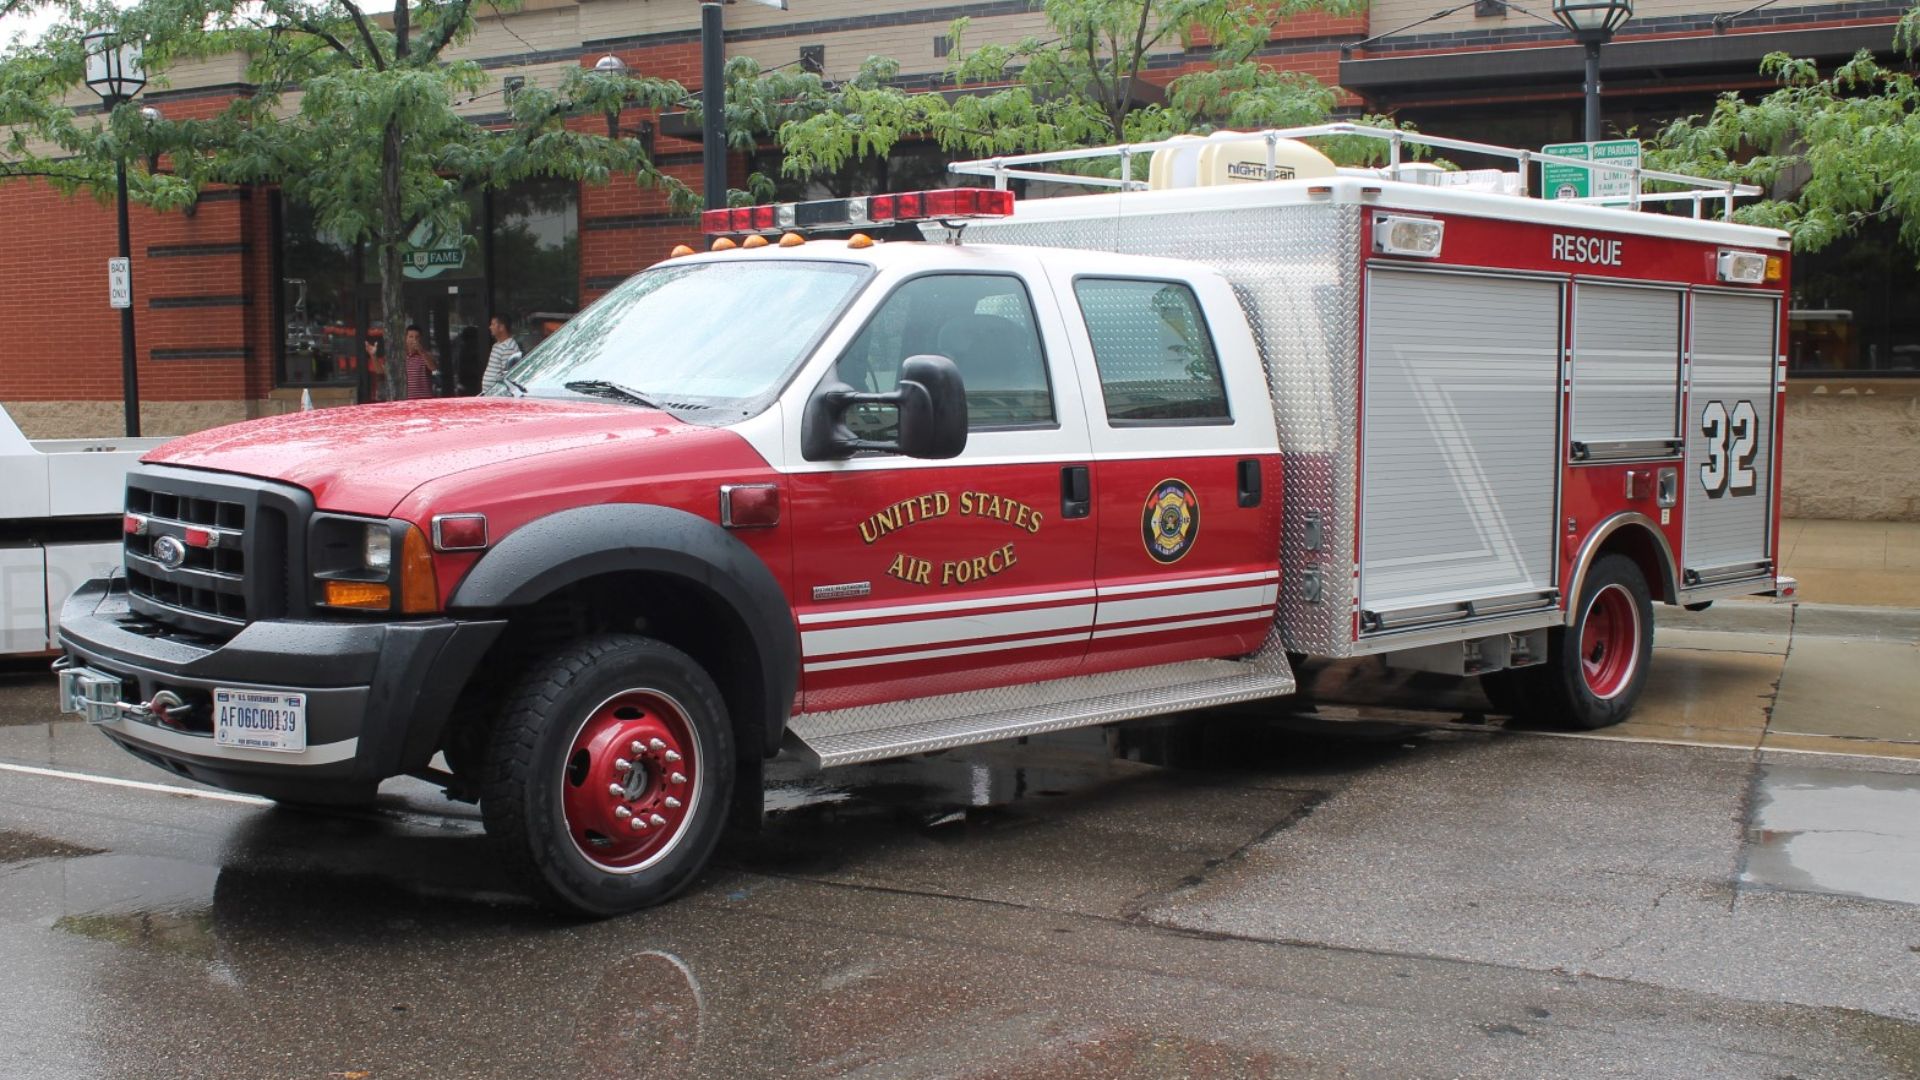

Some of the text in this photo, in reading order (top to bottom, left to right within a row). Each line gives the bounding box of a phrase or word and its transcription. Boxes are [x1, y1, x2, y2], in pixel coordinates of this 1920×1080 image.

[1594, 146, 1607, 157] PAY
[1607, 144, 1638, 156] PARKING
[430, 251, 459, 263] FAME
[1552, 233, 1622, 266] RESCUE
[111, 263, 127, 273] BACK
[115, 276, 122, 285] IN
[112, 289, 127, 299] ONLY
[1701, 400, 1759, 498] 32
[858, 490, 1044, 544] UNITED STATES
[886, 542, 1017, 586] AIR FORCE
[220, 706, 296, 732] AF06C00139
